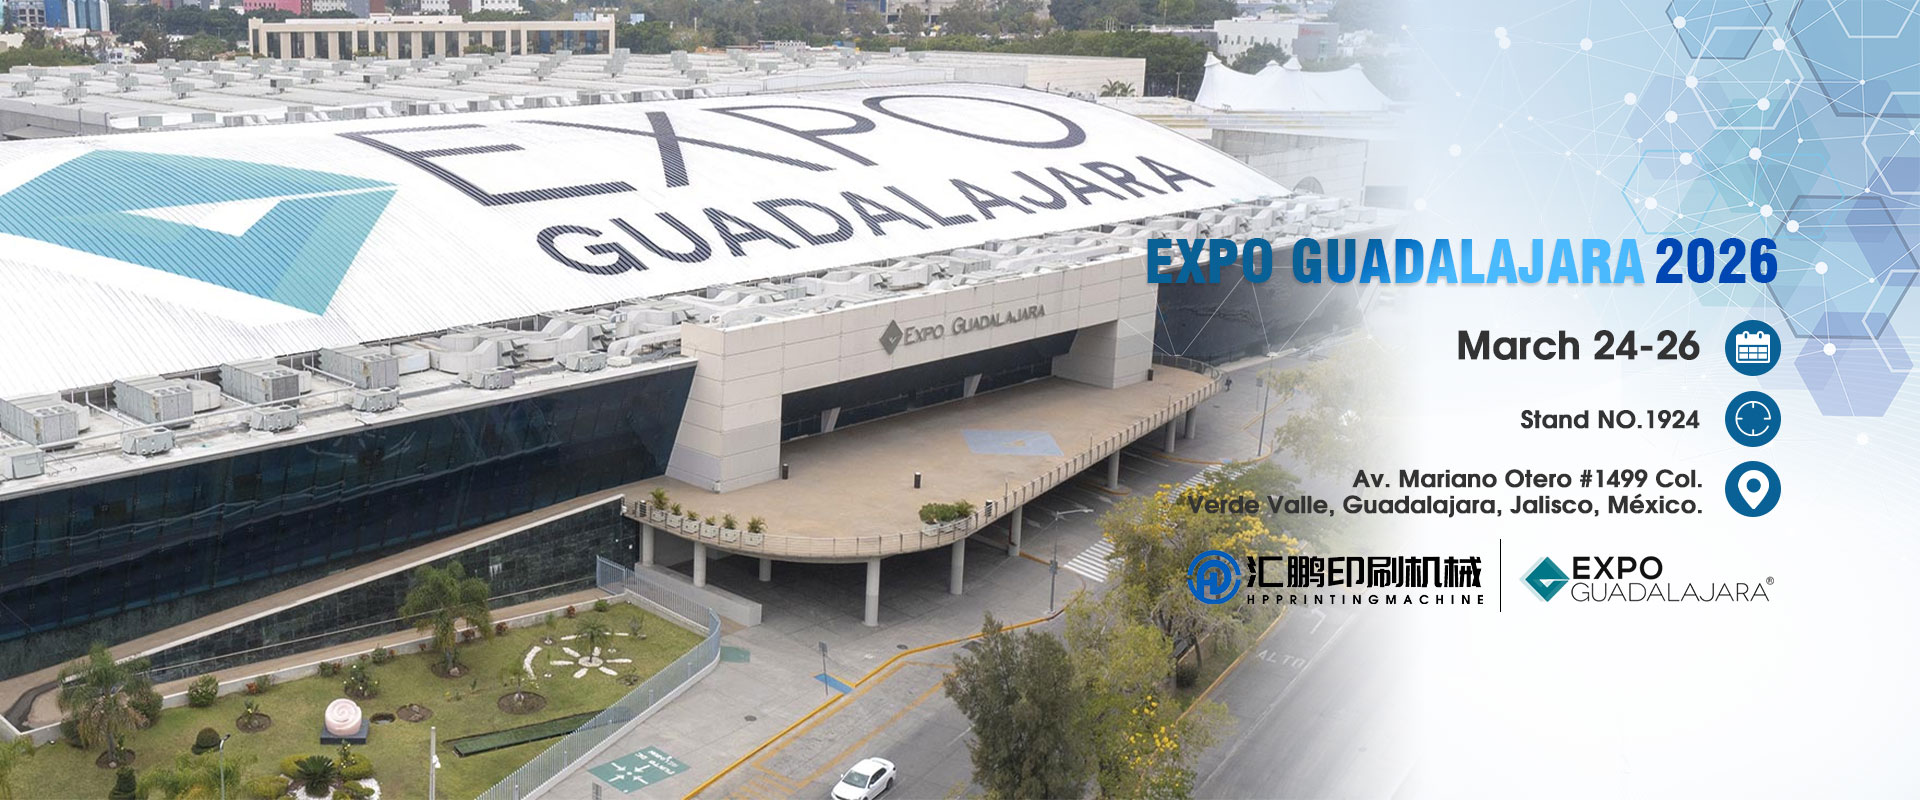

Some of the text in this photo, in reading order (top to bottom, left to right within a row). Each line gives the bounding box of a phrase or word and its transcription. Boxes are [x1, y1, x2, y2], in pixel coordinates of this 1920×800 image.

[335, 94, 1086, 207] EXPO
[536, 155, 1215, 276] GUADALAJARA
[951, 304, 1046, 335] GUADALAJARA
